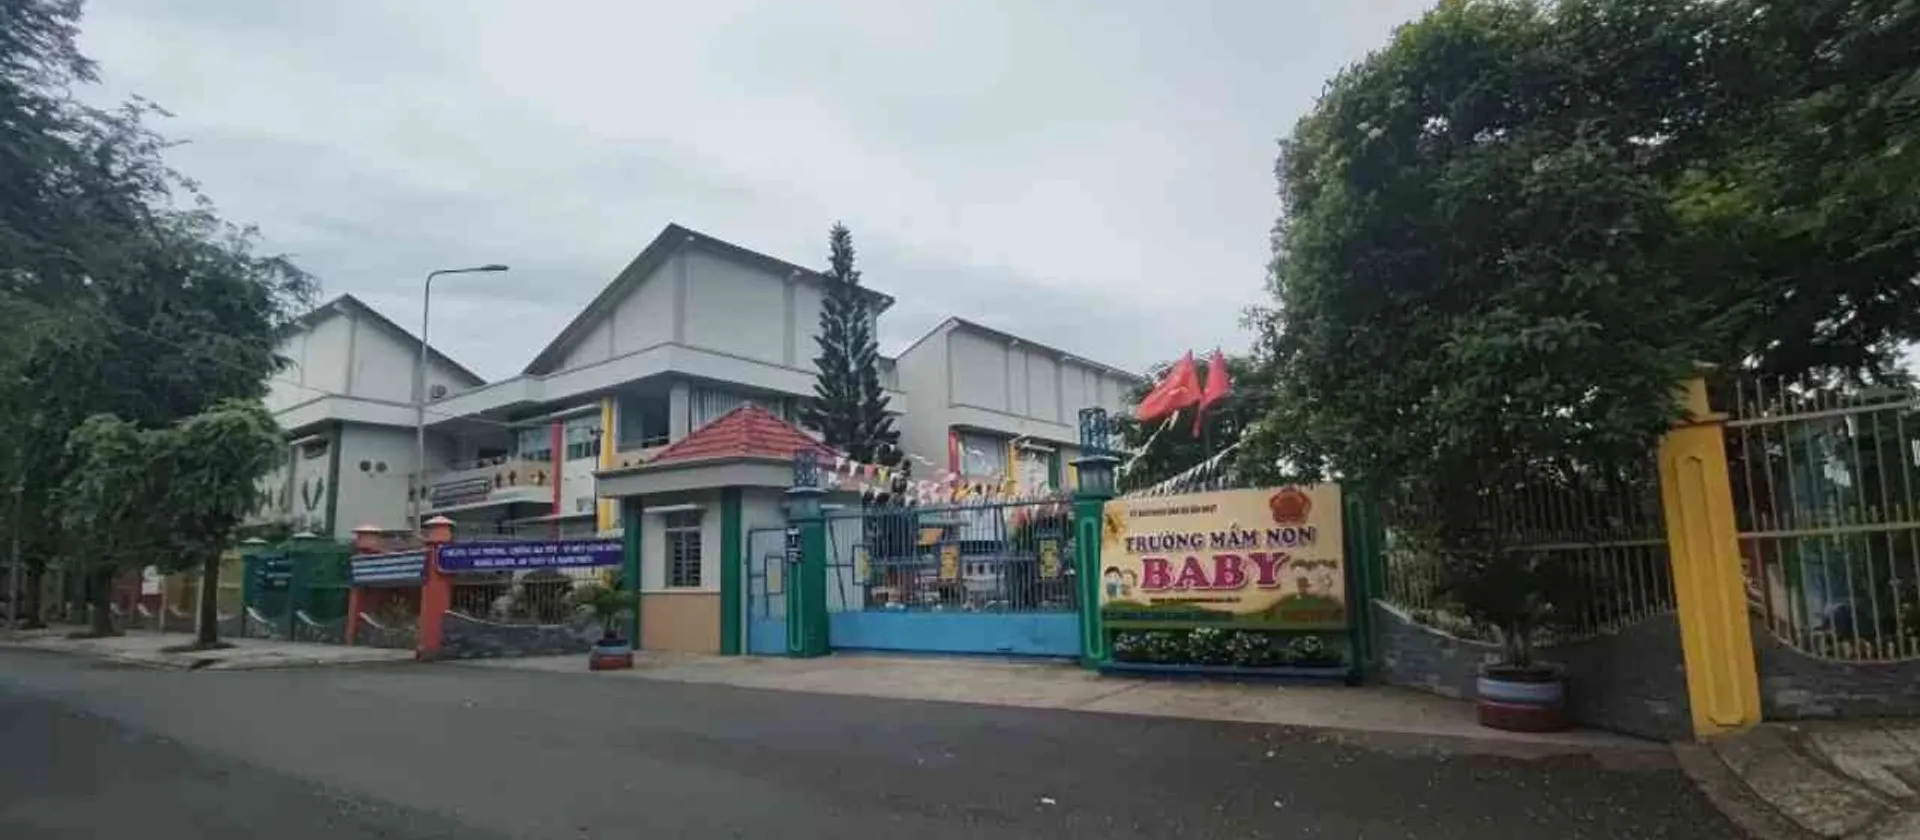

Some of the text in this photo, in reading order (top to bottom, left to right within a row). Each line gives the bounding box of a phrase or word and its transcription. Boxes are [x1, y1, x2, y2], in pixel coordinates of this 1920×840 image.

[1124, 529, 1203, 551] TRƯỜNG
[1266, 525, 1316, 545] NON
[1140, 551, 1291, 590] BABY
